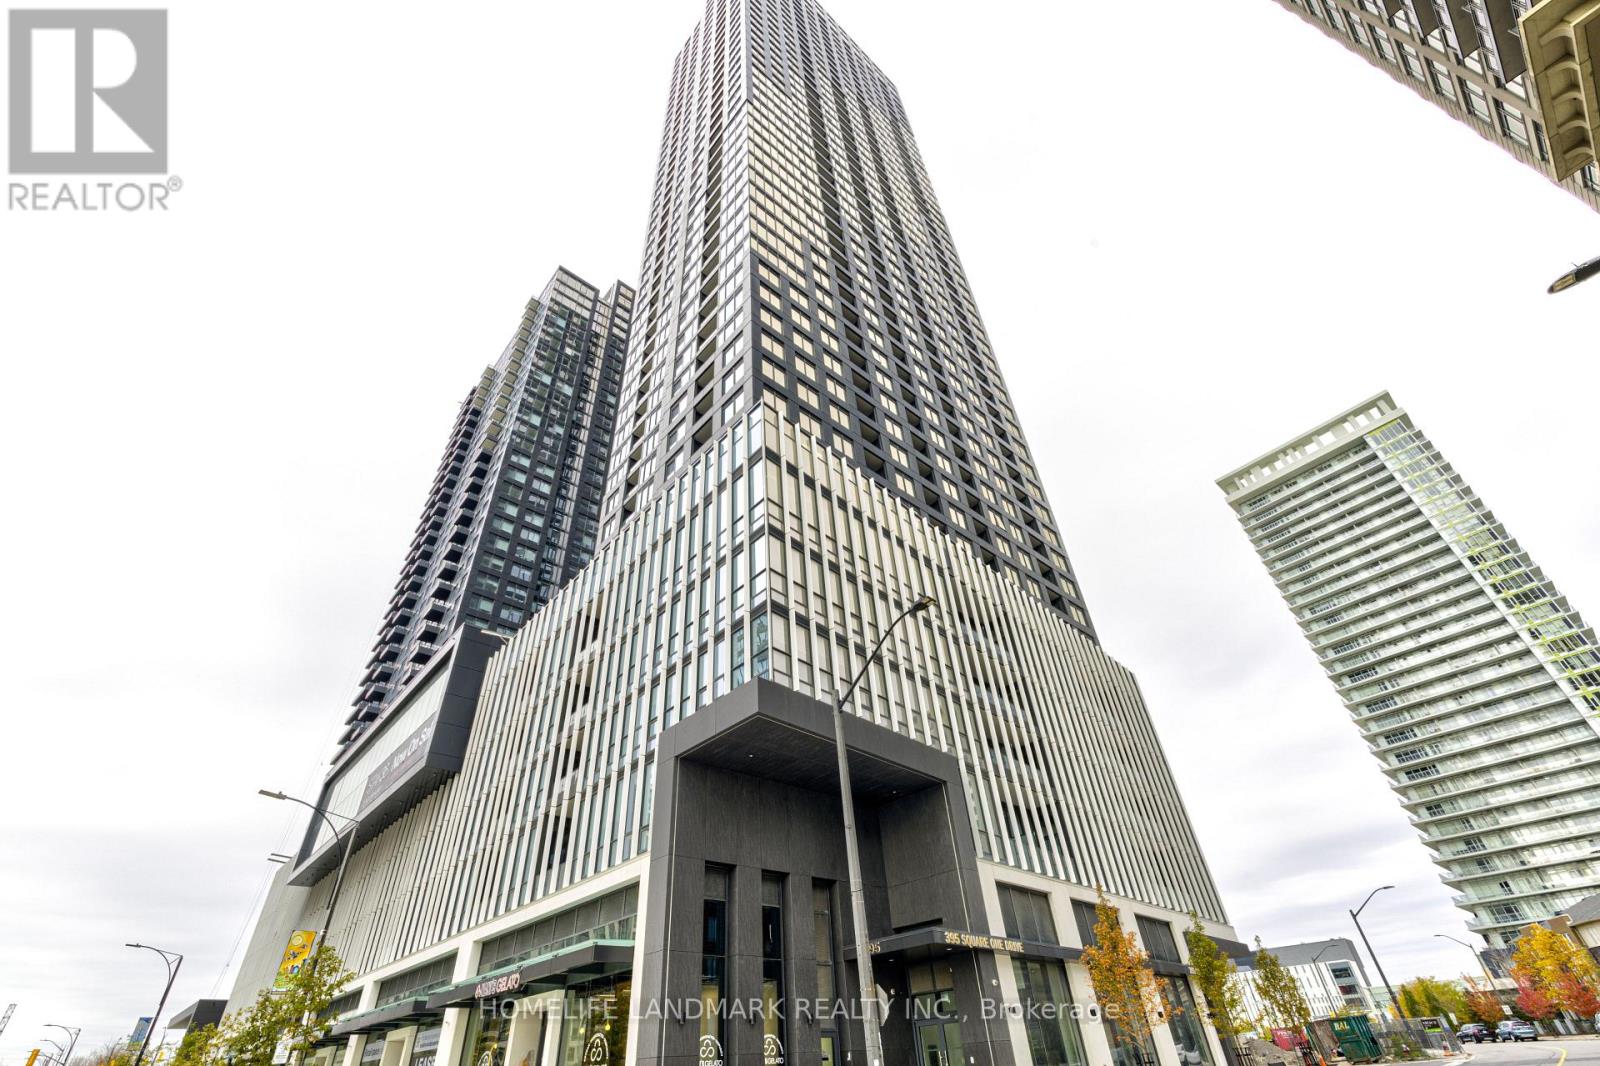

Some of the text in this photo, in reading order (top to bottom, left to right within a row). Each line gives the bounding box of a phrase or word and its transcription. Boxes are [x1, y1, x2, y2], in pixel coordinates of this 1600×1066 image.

[944, 931, 1025, 953] 395 SQUARE ONE DRIVE
